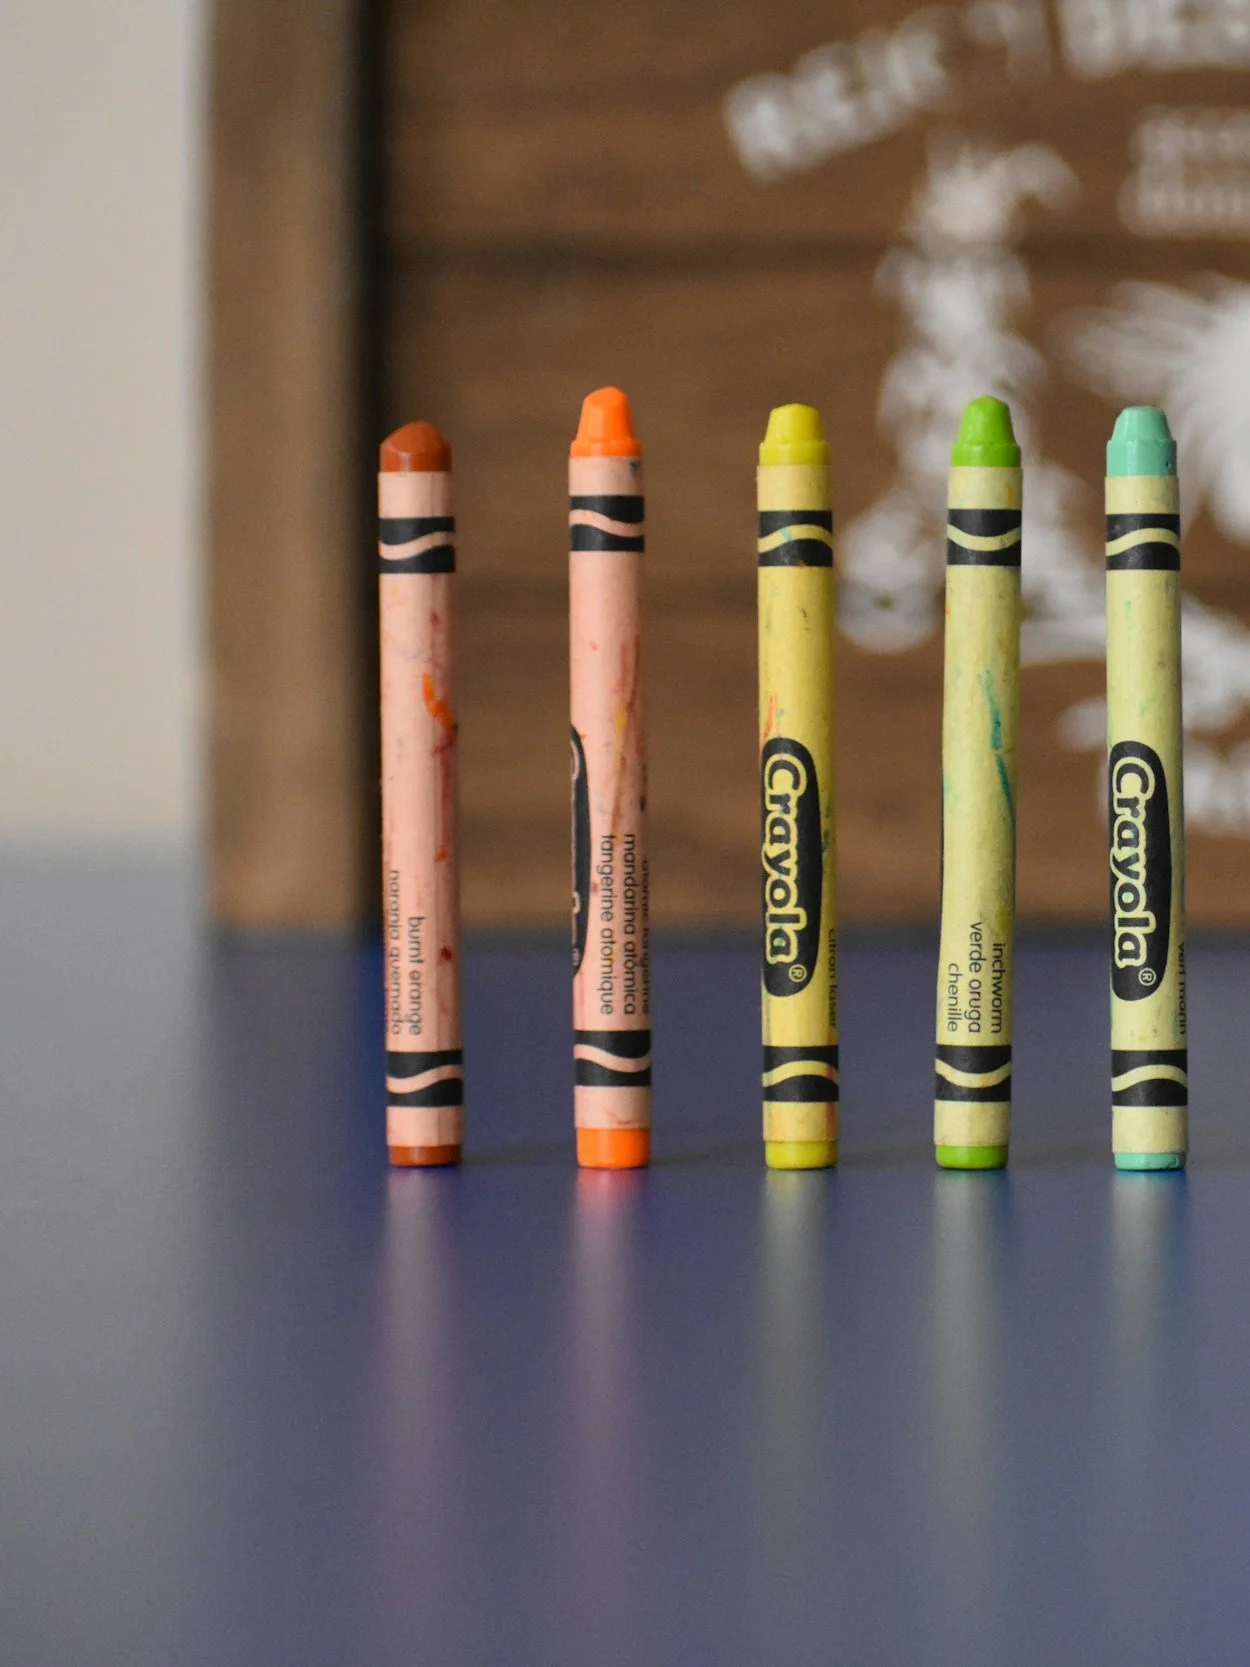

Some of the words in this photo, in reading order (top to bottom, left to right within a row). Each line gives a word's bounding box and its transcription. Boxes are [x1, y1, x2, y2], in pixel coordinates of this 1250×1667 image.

[597, 834, 617, 921] tangerine
[623, 833, 639, 934] mandarina
[761, 753, 807, 965] Crayola
[1111, 757, 1156, 968] Crayola
[388, 869, 401, 940] naranja
[408, 916, 426, 964] burnt
[597, 928, 616, 1015] atomique
[623, 941, 640, 1015] atómica
[968, 922, 986, 973] verde
[387, 946, 404, 1035] quemado
[405, 970, 422, 1036] orange
[947, 963, 963, 1032] chenille
[964, 979, 982, 1033] oruga
[990, 943, 1006, 1033] inchworm
